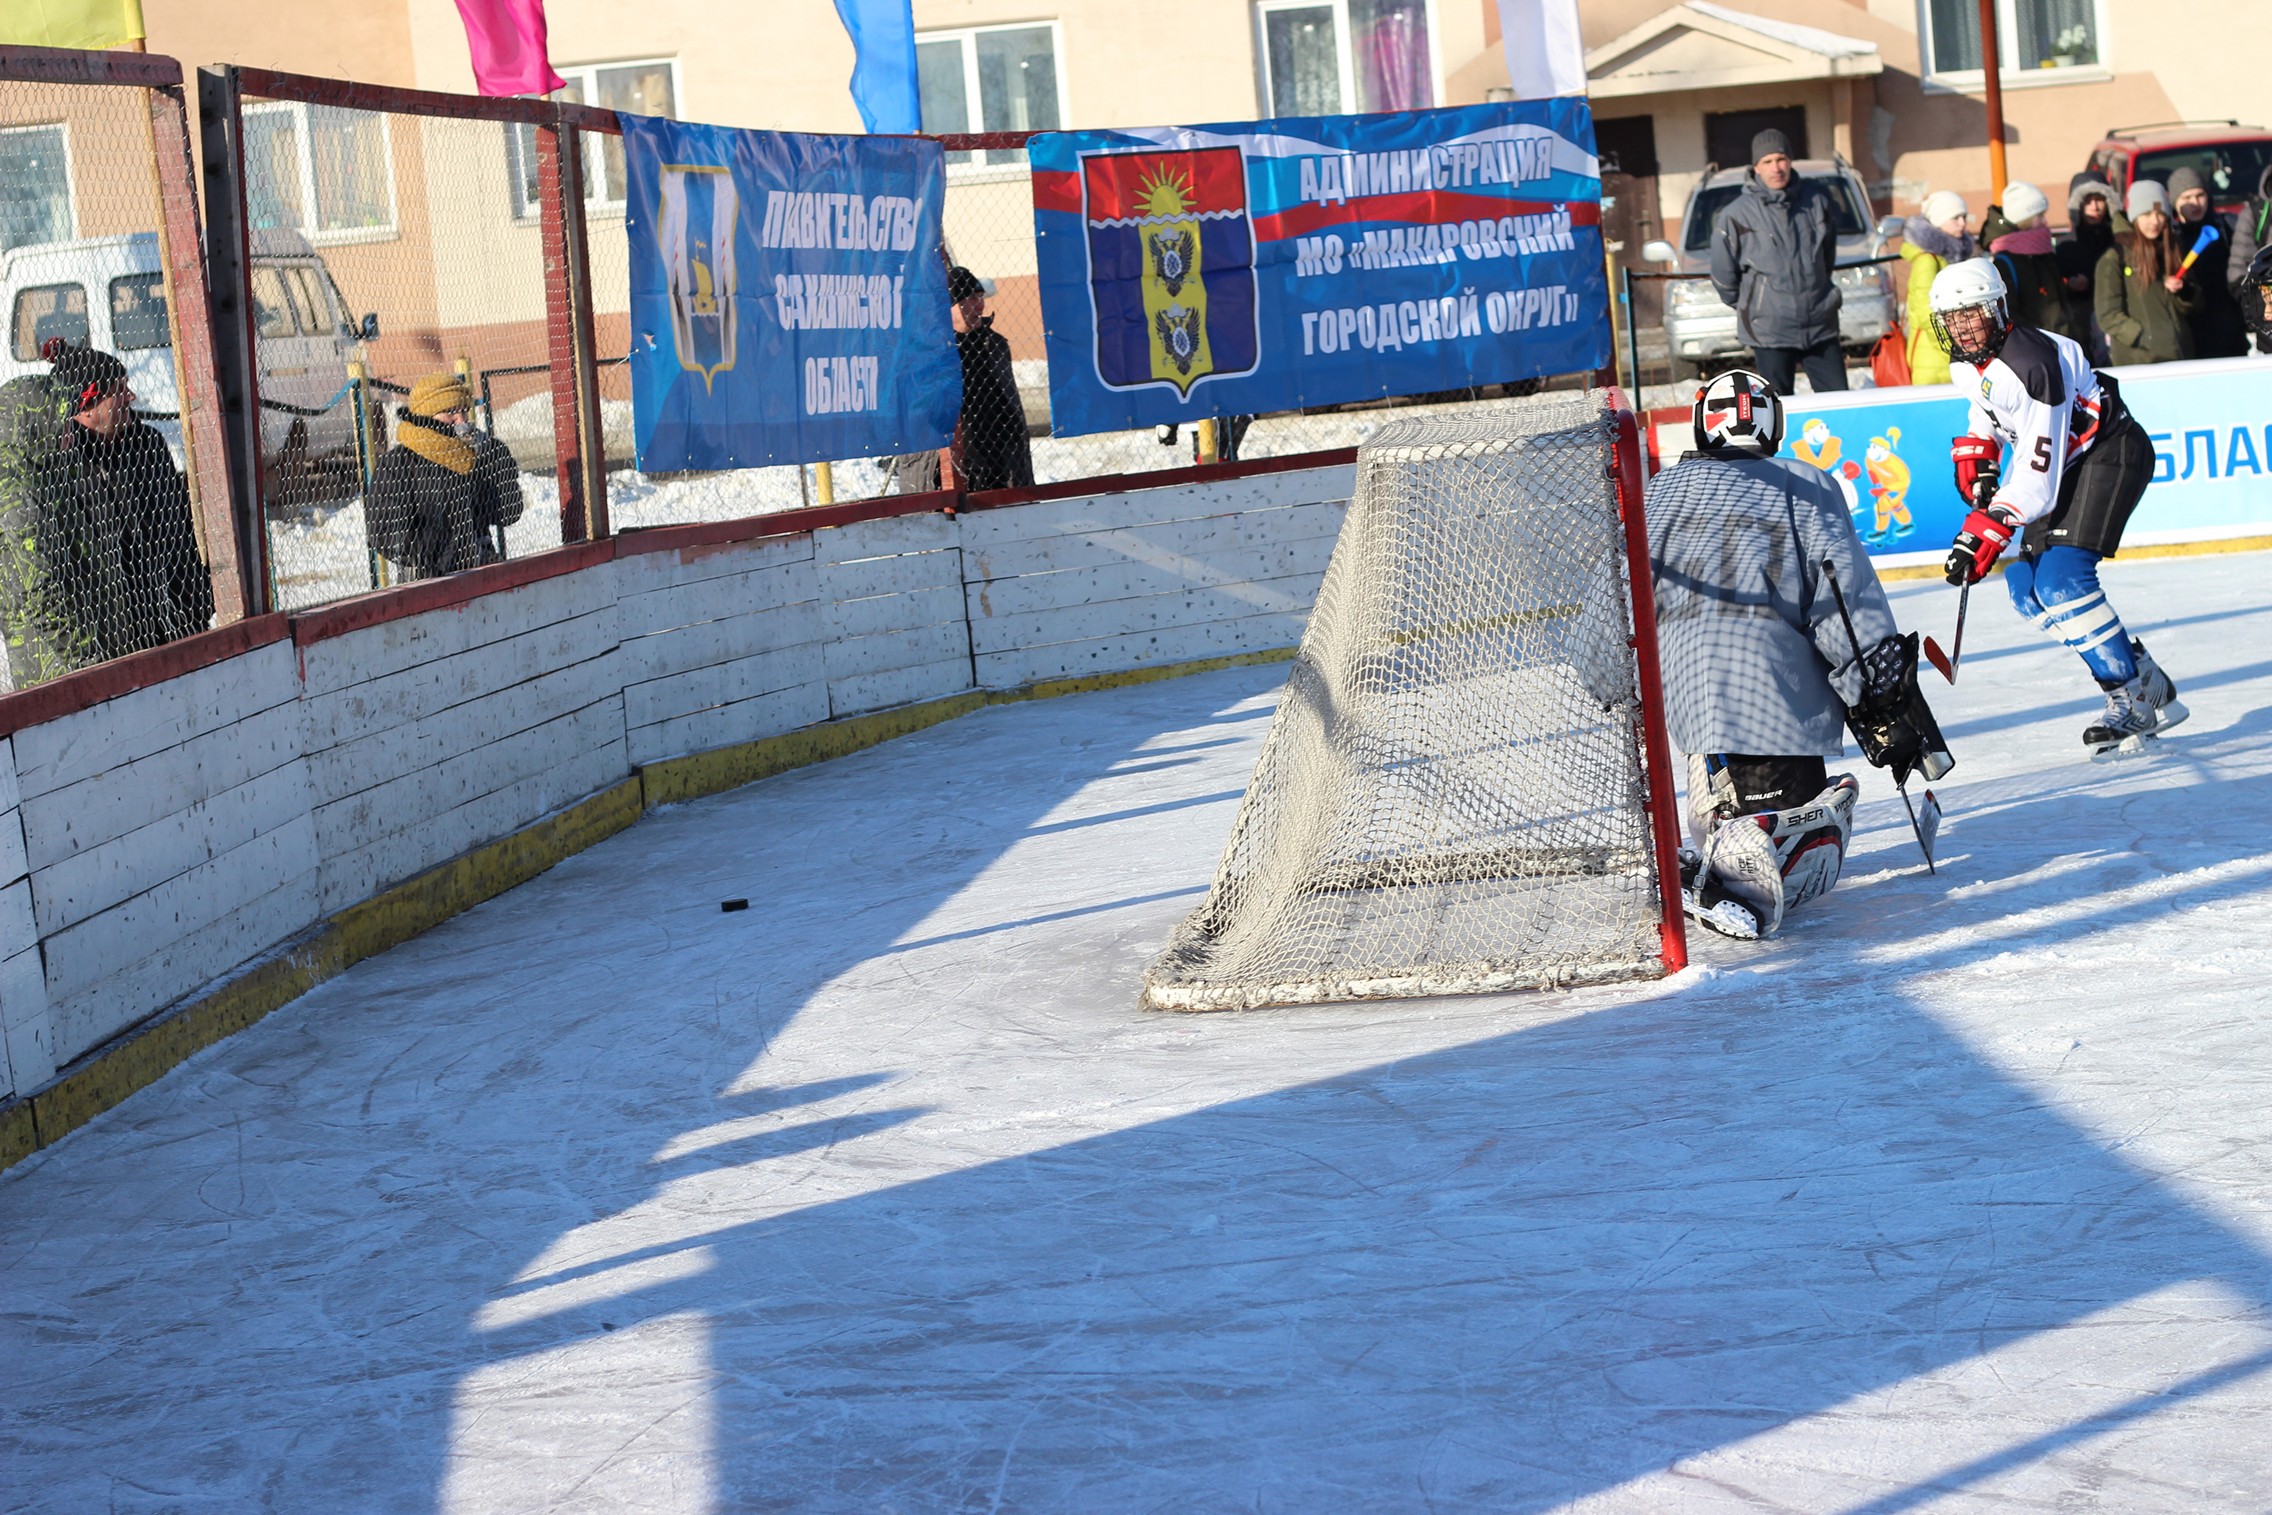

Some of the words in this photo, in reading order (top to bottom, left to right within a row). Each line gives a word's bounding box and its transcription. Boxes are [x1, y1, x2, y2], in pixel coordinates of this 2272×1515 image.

[1300, 137, 1552, 207] АДМИНИСТРАЦИЯ
[1295, 234, 1344, 278] МО
[1302, 287, 1482, 355] ГОРОДСКОЙ
[2030, 436, 2053, 474] 5
[2150, 424, 2272, 484] БЛА
[1744, 789, 1783, 801] BAUER
[1786, 808, 1824, 828] SHER
